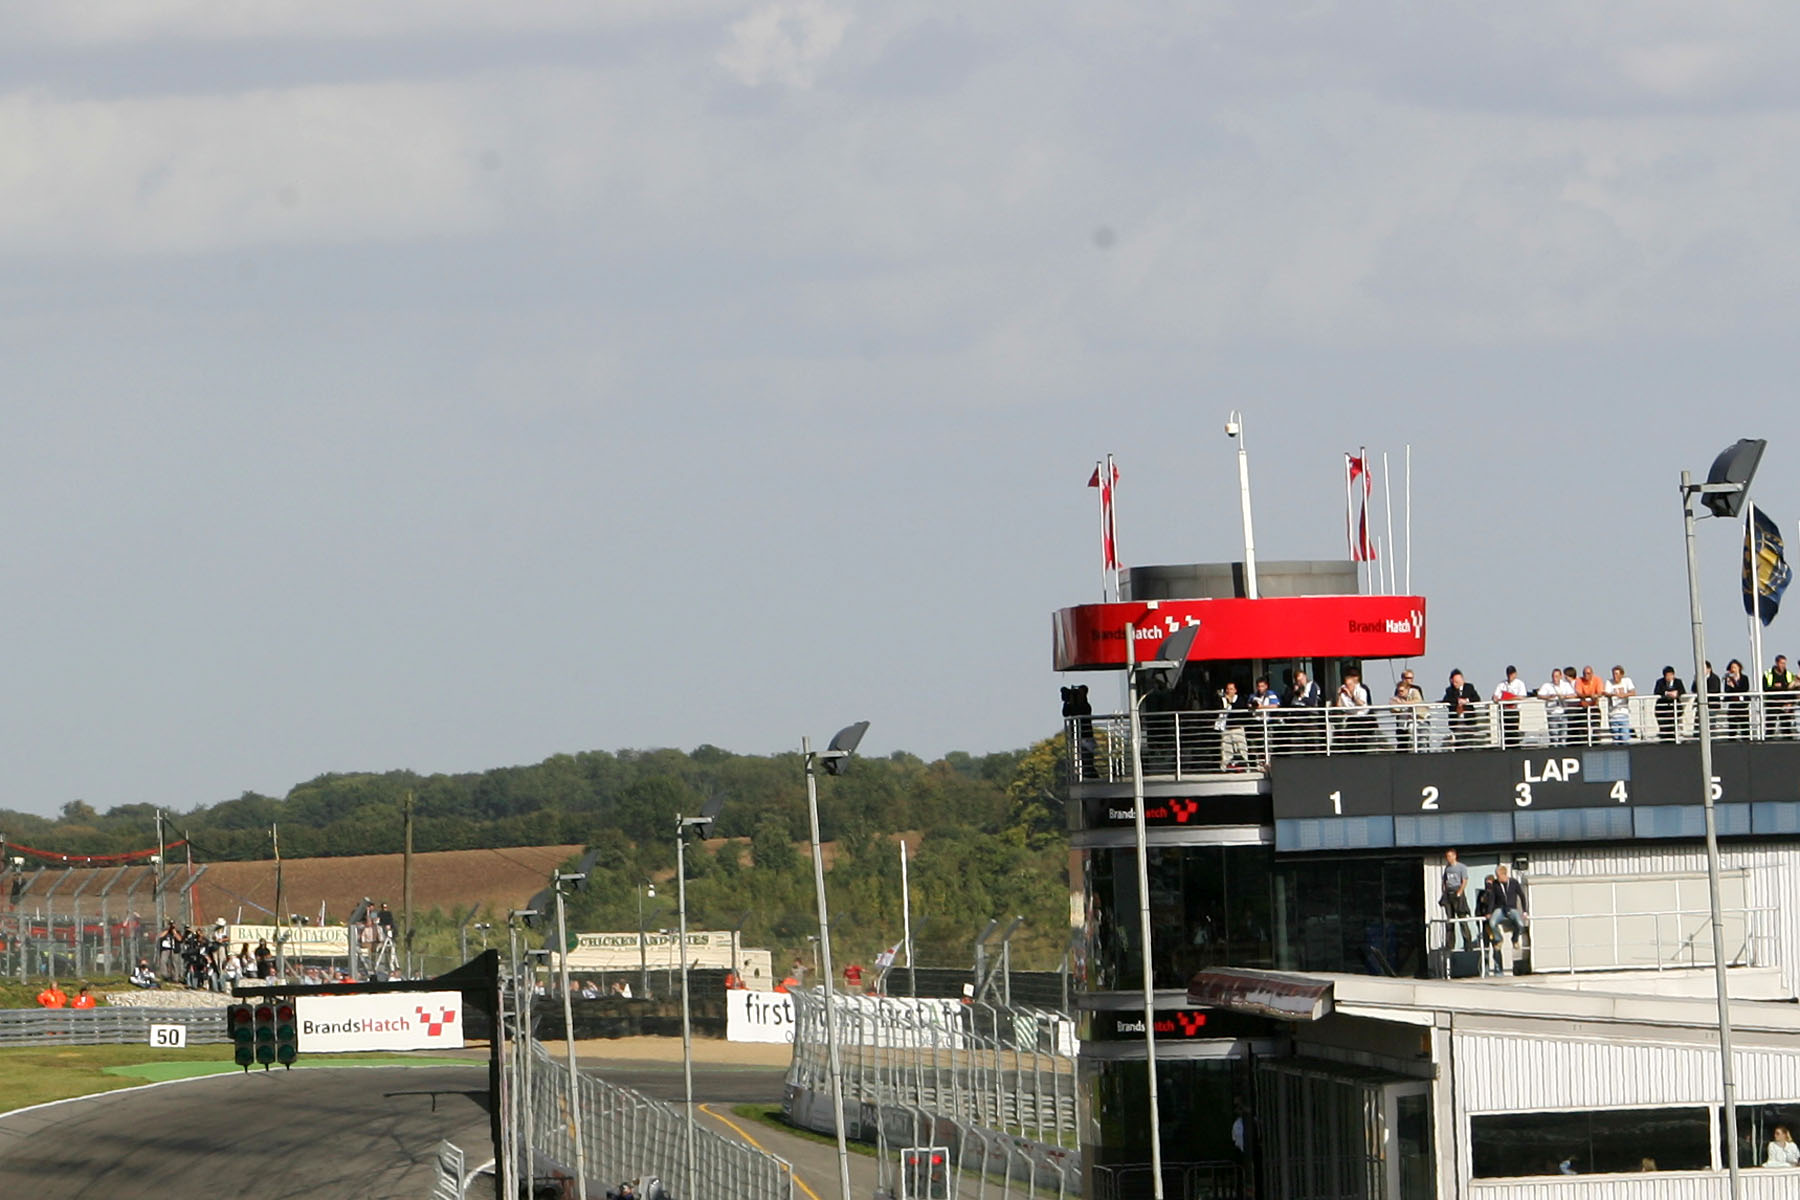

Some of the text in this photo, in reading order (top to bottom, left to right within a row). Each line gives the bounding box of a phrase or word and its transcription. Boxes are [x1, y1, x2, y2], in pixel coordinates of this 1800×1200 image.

[1092, 624, 1163, 641] Brandsatch
[1349, 618, 1411, 634] BrandsHatch
[1524, 758, 1580, 783] LAP
[1329, 790, 1343, 815] 1
[1421, 785, 1440, 810] 2
[1515, 782, 1533, 807] 3
[1609, 780, 1628, 803] 4
[1108, 806, 1169, 820] Brandsatch
[238, 927, 273, 940] BAKE
[579, 936, 638, 947] CHICKEN
[745, 994, 794, 1025] first
[303, 1016, 410, 1035] BrandsHatch
[156, 1028, 180, 1046] 50
